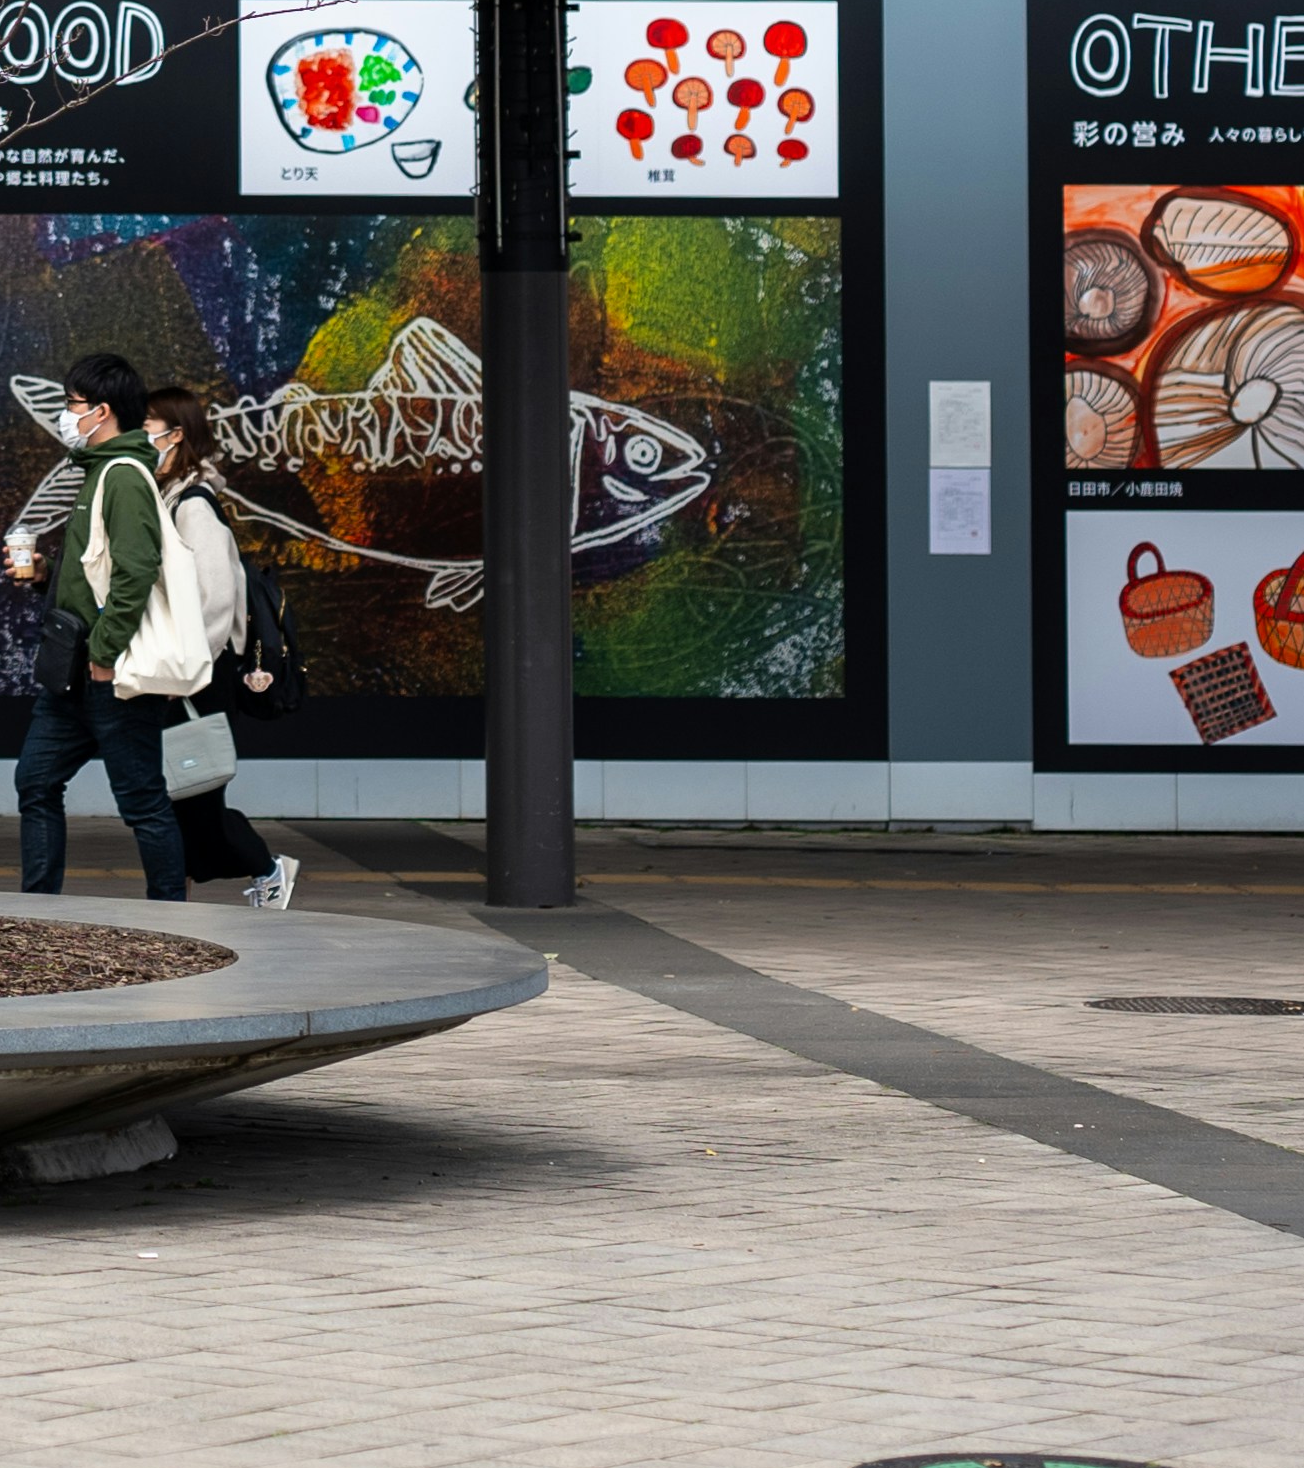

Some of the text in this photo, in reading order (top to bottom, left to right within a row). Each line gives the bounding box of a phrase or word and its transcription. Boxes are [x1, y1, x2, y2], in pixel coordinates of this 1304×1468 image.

[1072, 121, 1186, 147] 彩の営み
[281, 166, 319, 181] とり天
